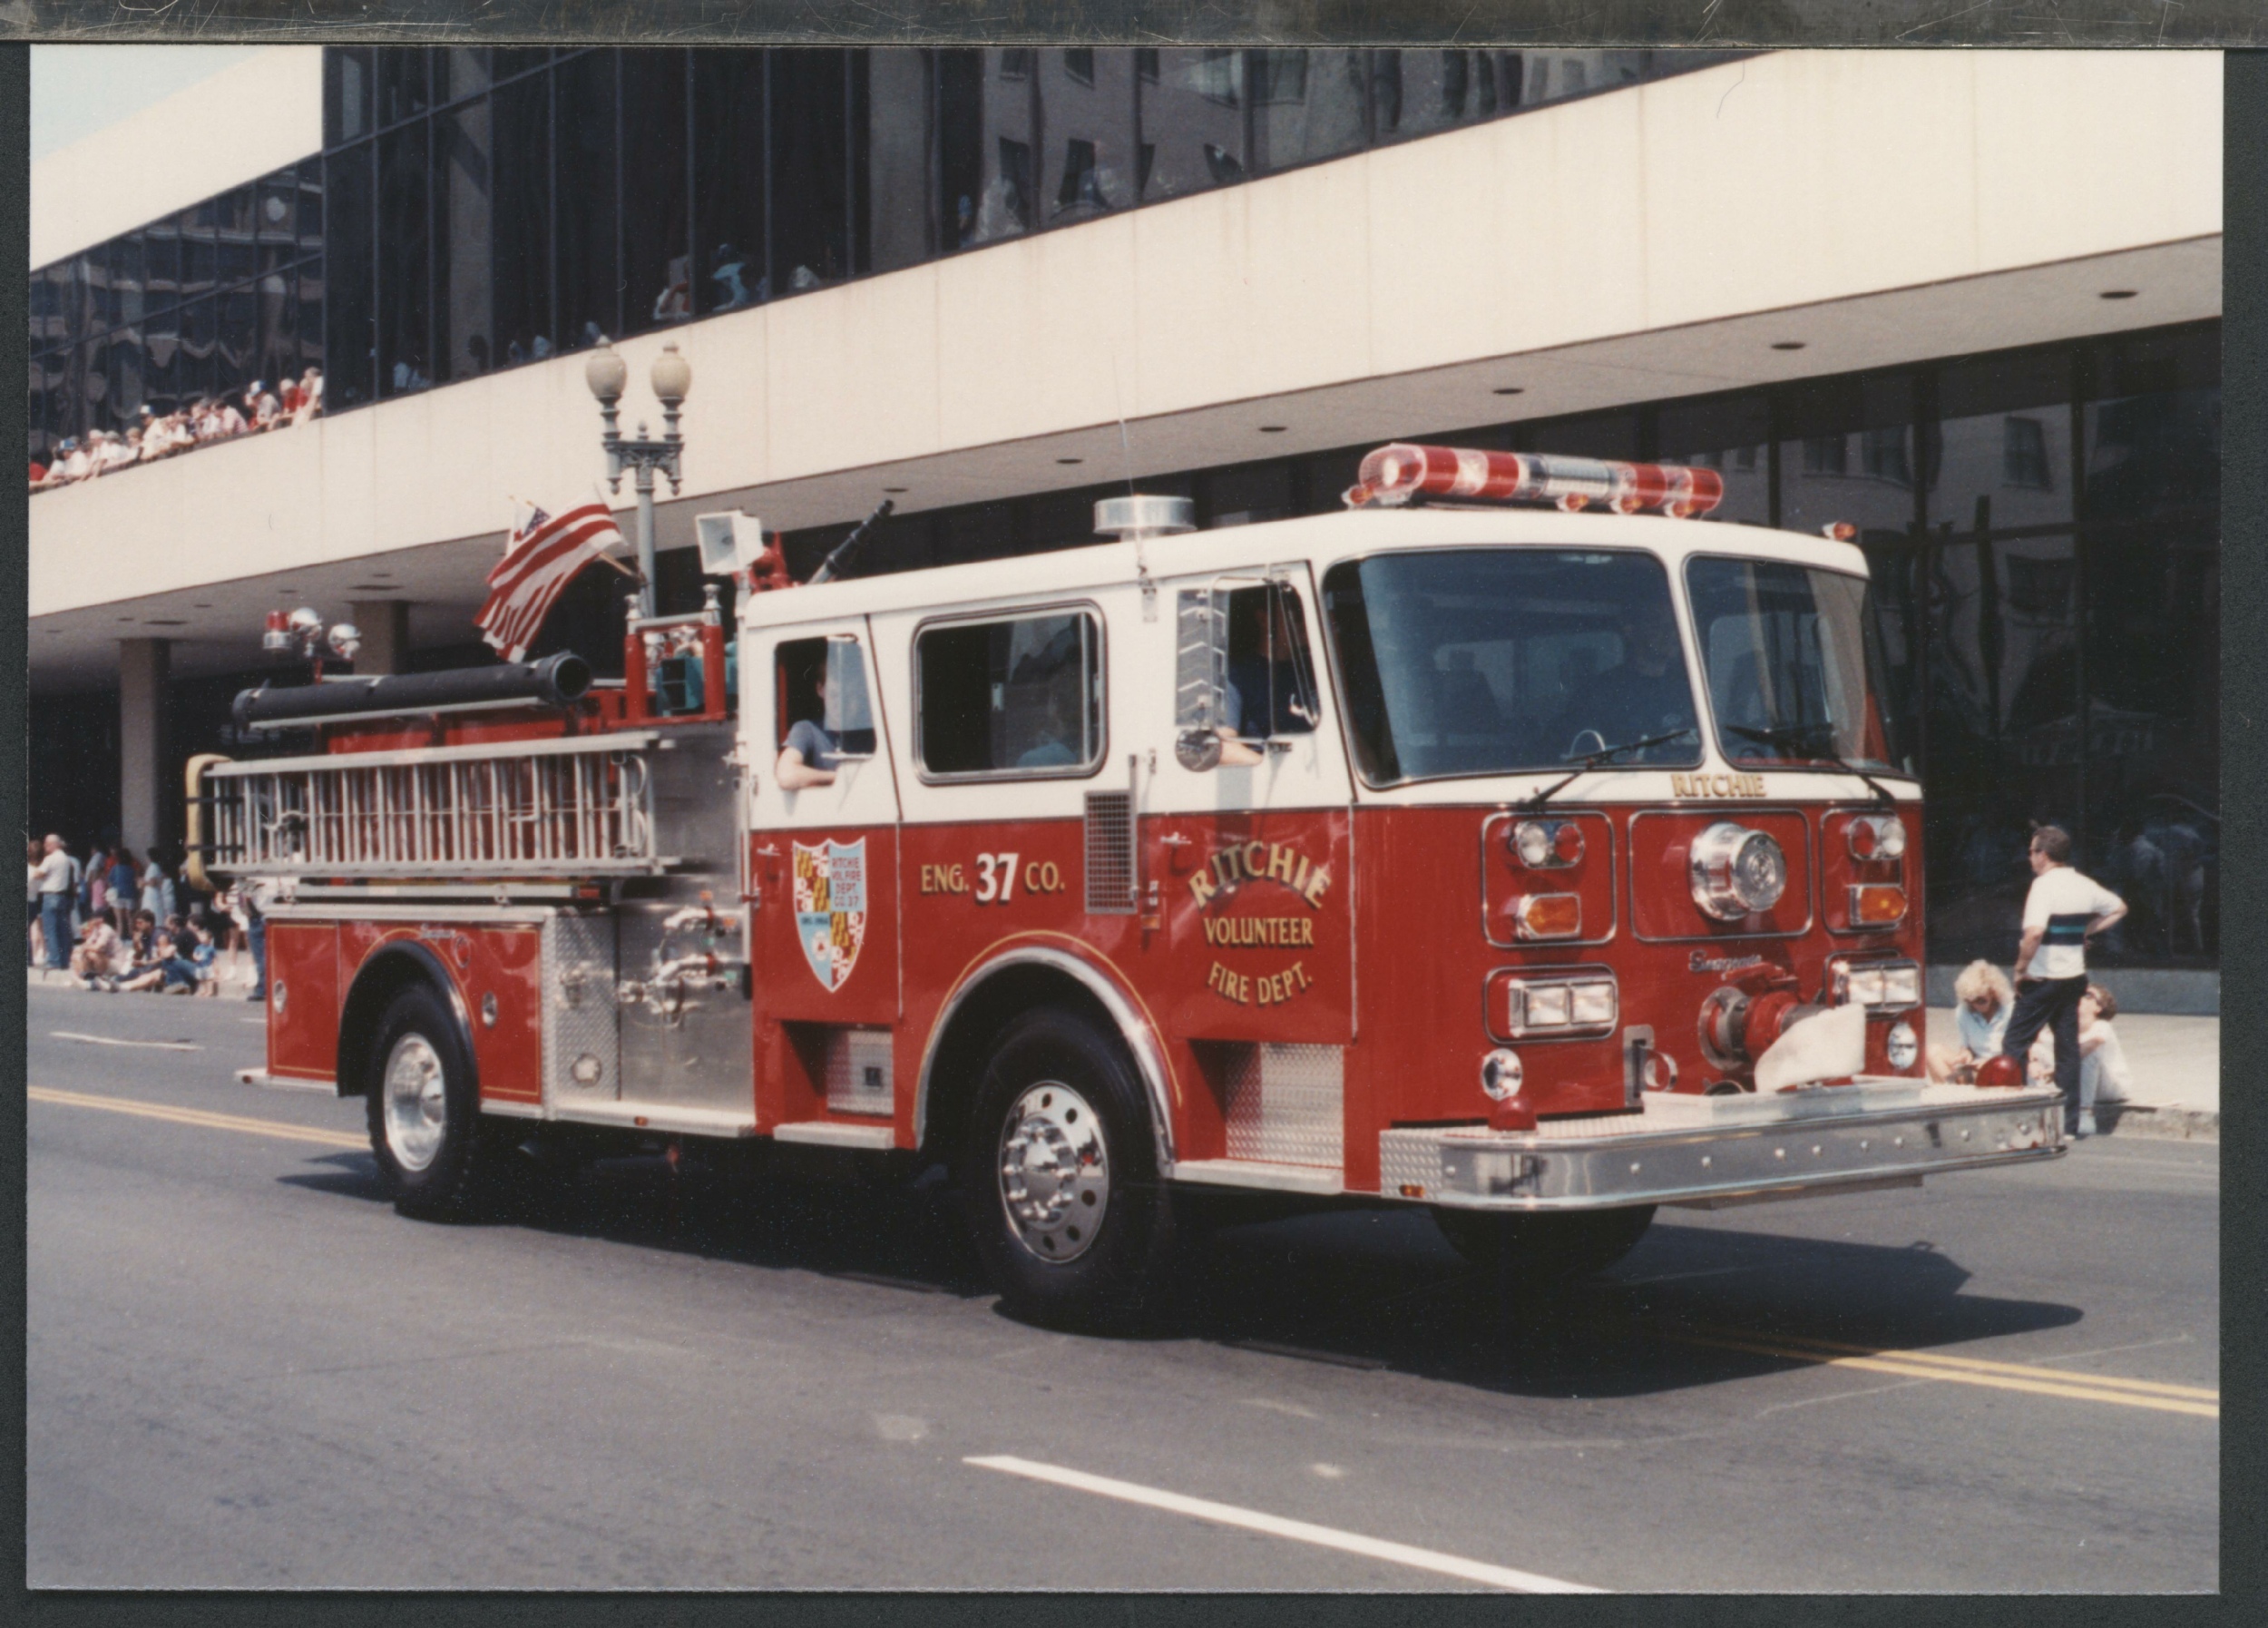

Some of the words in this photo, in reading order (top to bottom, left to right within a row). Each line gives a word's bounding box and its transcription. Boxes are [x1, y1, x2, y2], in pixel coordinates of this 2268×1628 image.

[1671, 773, 1767, 798] RITCHIE
[832, 857, 860, 868] RITCHIE
[921, 863, 970, 894] ENG.
[975, 852, 1020, 903] 37
[1024, 860, 1066, 893] CO.
[1188, 839, 1332, 910] RITCHIE
[1204, 917, 1315, 946] VOLUNTEER
[1207, 960, 1250, 1004] FIRE
[1256, 960, 1314, 1005] DEPT.
